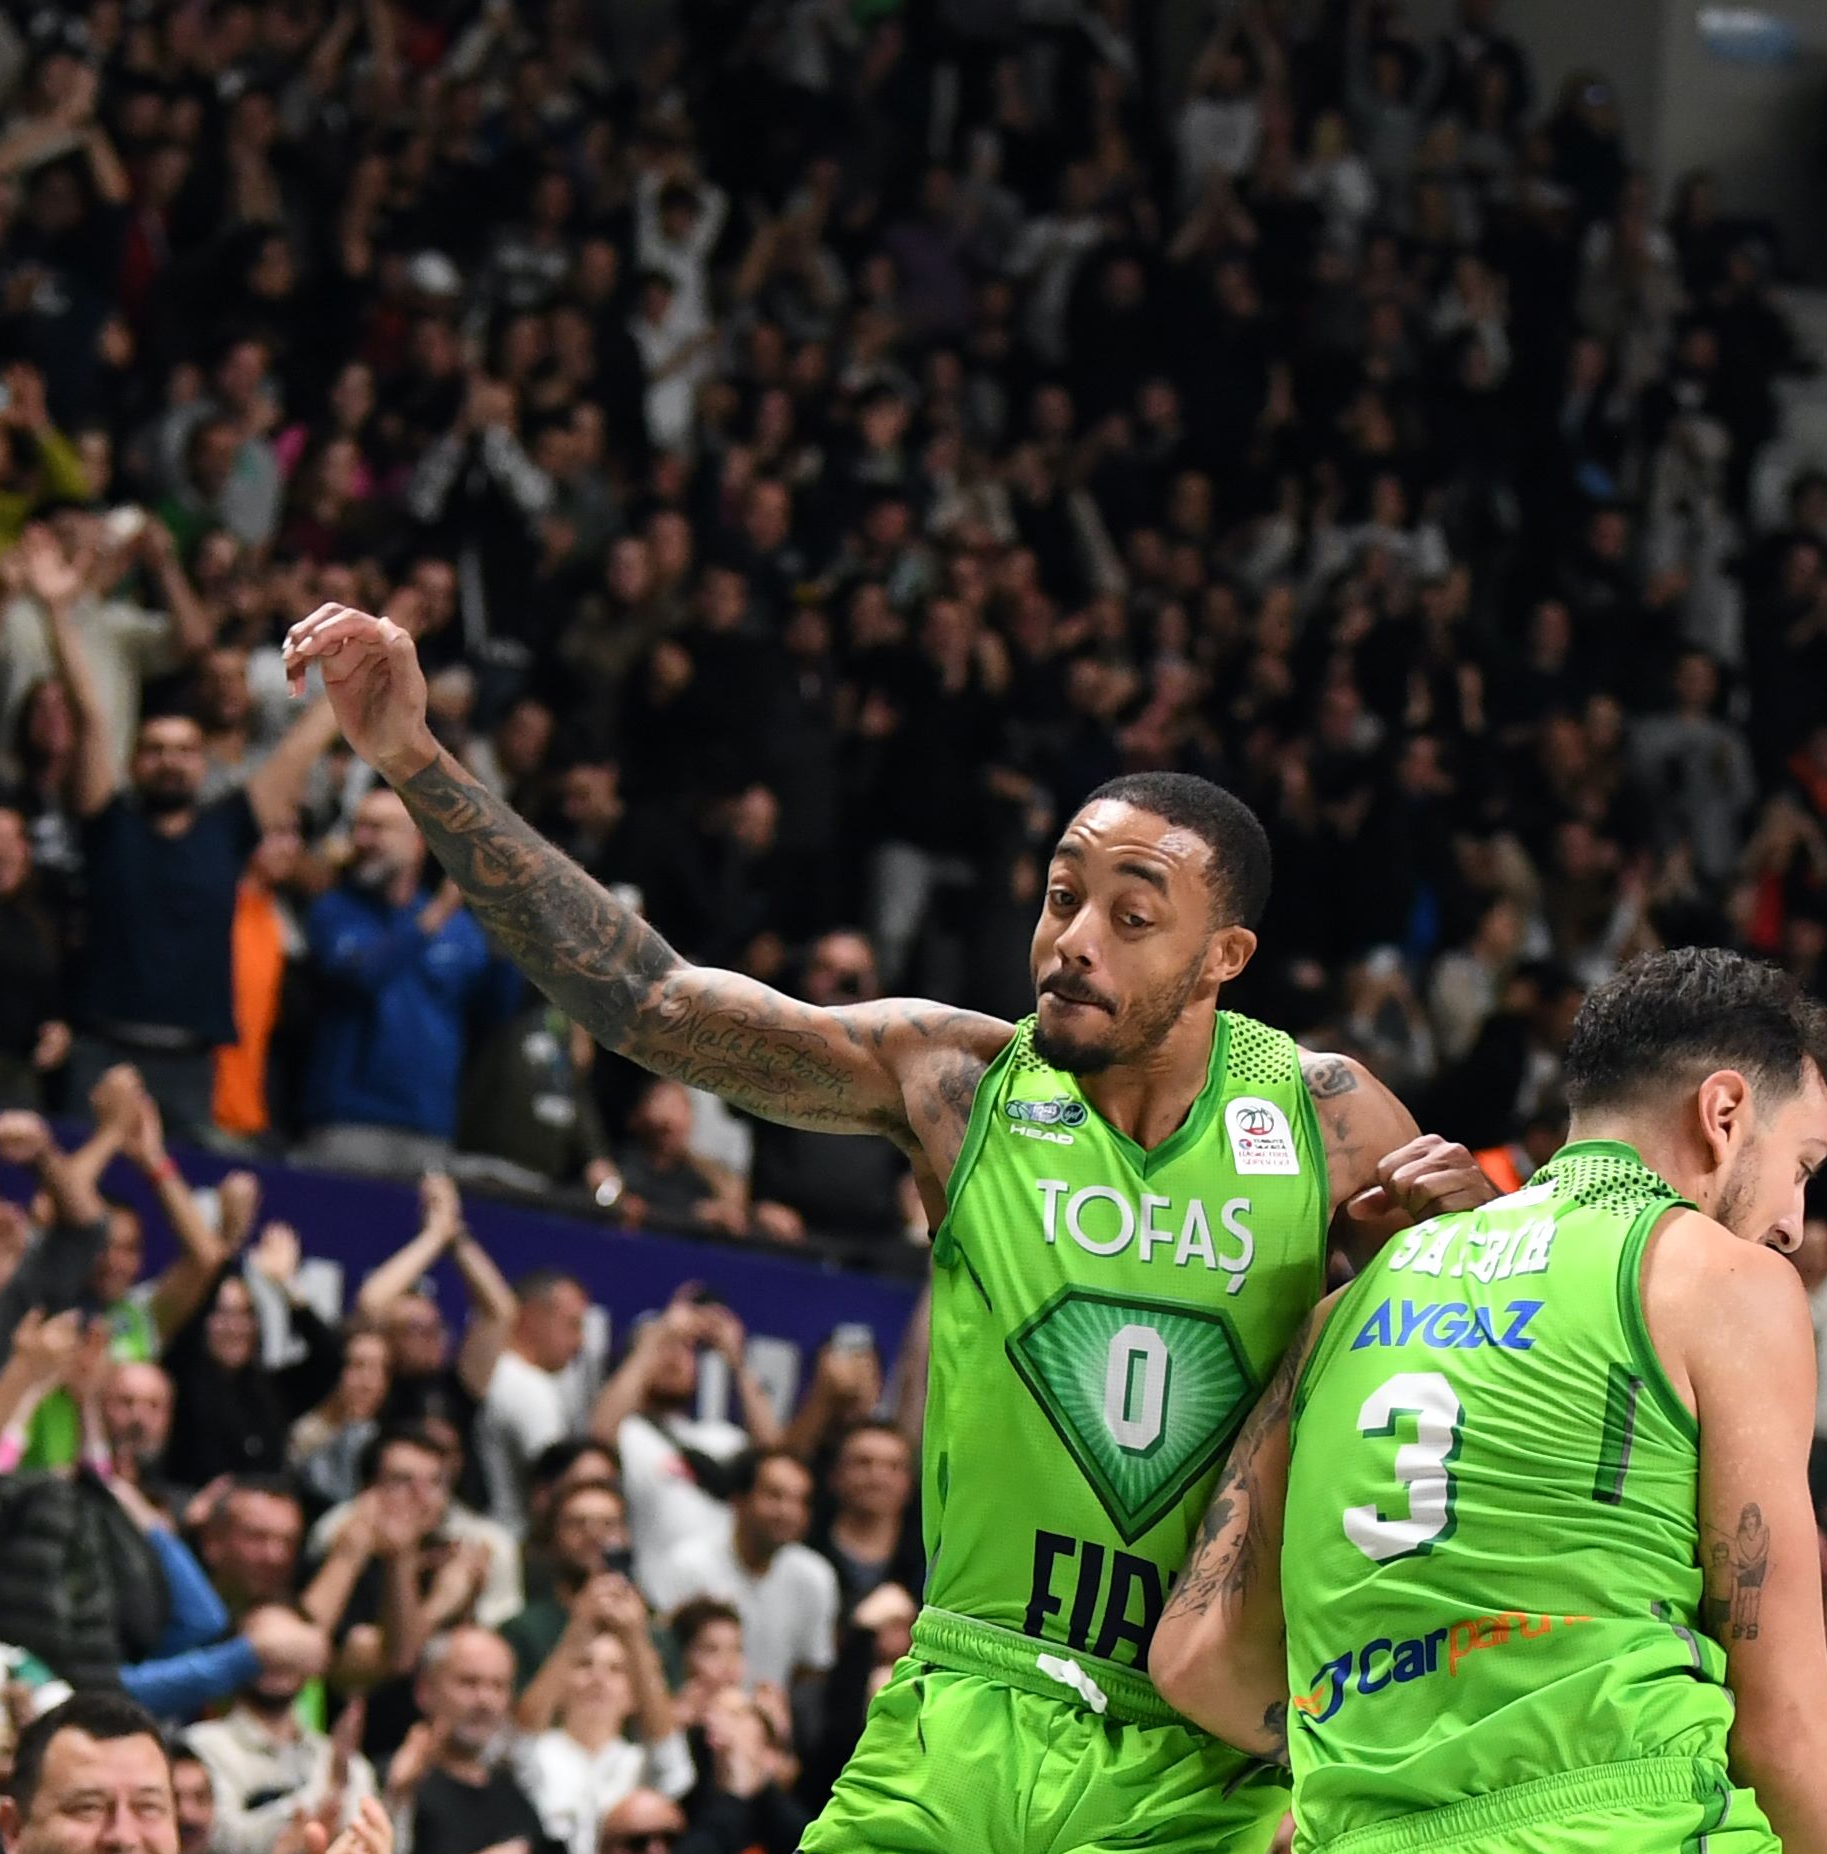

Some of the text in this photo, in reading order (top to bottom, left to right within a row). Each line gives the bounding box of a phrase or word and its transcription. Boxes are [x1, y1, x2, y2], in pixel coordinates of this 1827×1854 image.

[1009, 1123, 1075, 1146] HEAD
[1036, 1178, 1255, 1296] TOFAŞ
[1350, 1298, 1545, 1351] AYGAZ
[1103, 1323, 1173, 1460] 0
[1343, 1371, 1466, 1567] 3
[1023, 1529, 1178, 1673] FIA
